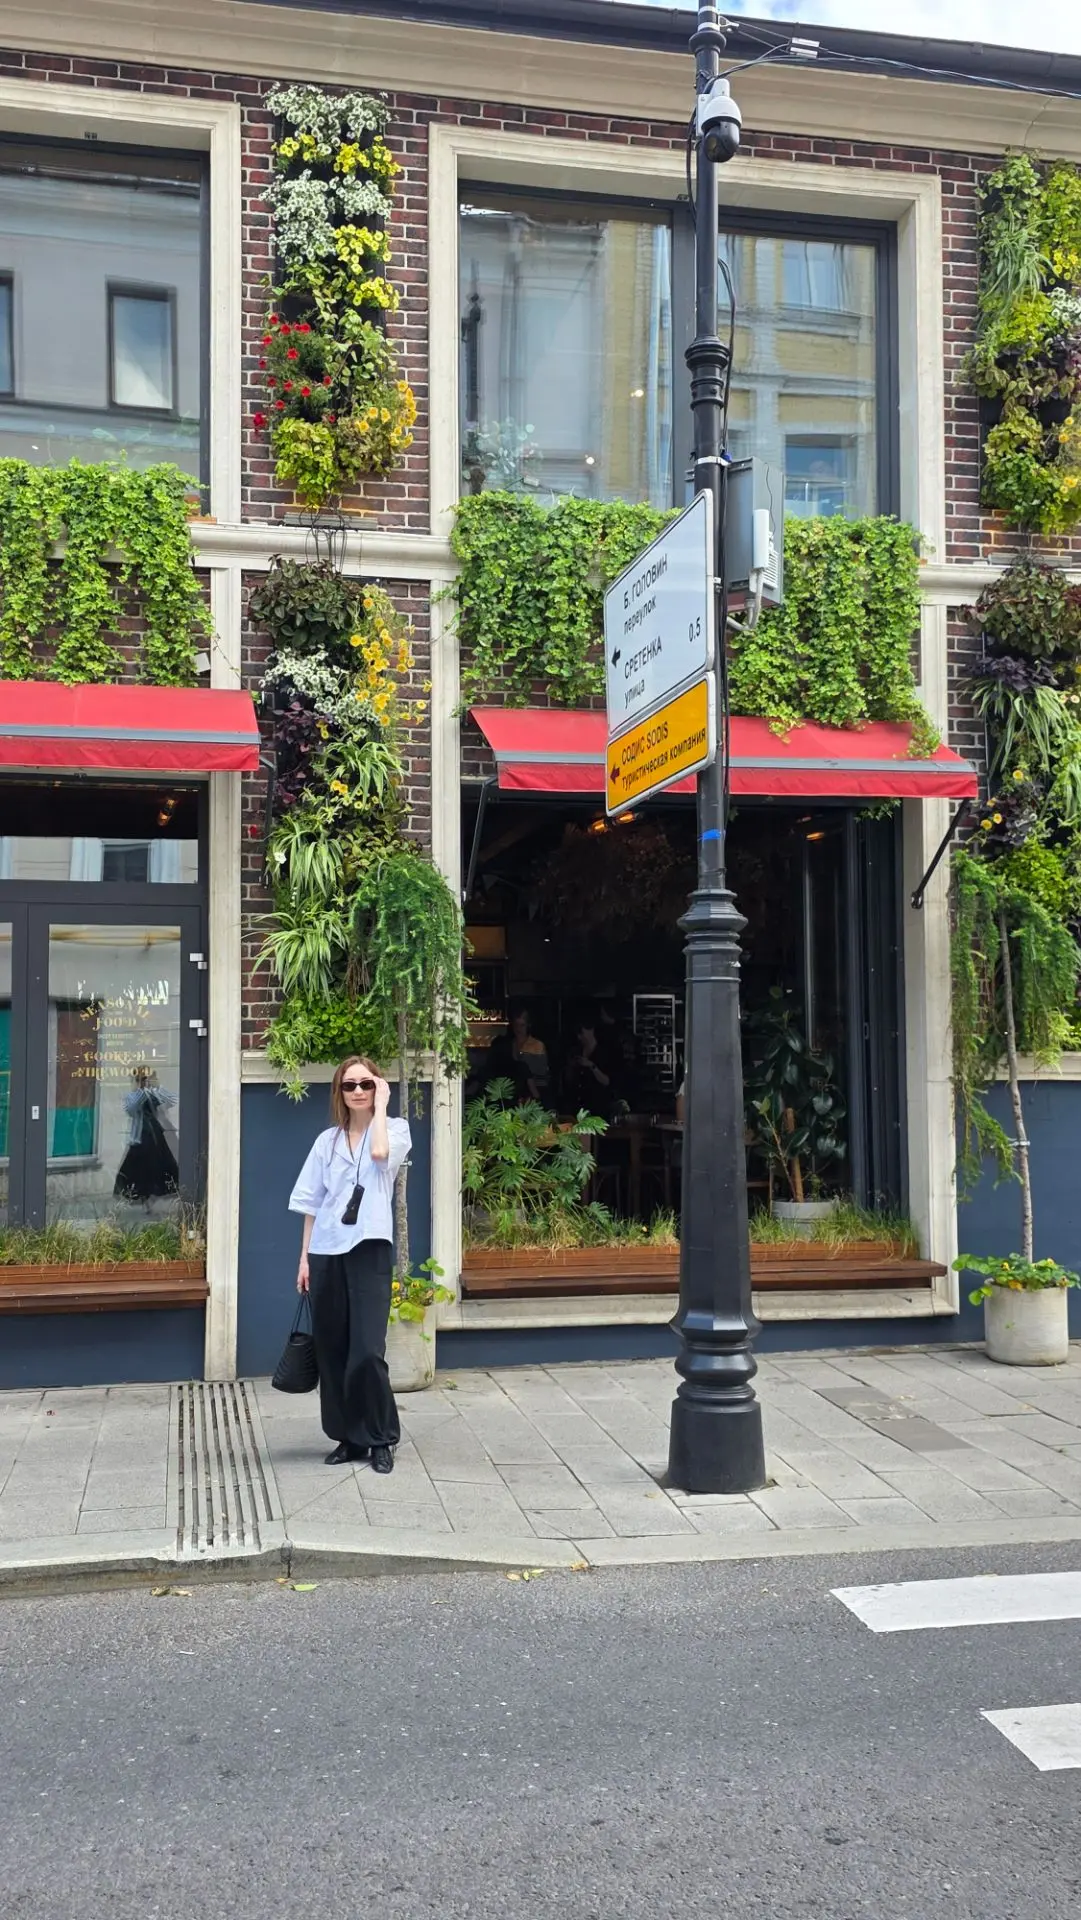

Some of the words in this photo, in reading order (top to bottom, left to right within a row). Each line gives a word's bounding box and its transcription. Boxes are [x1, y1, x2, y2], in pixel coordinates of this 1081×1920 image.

[624, 591, 630, 610] Б.
[632, 553, 668, 602] ГОЛОВИН
[624, 595, 657, 635] переулок
[688, 616, 701, 643] 0.5
[624, 635, 663, 680] СРЕТЕНКА
[624, 679, 645, 709] улица
[621, 736, 645, 766] СОДИС
[646, 721, 669, 750] SODIS
[622, 751, 669, 792] туристическая
[669, 727, 706, 761] компания
